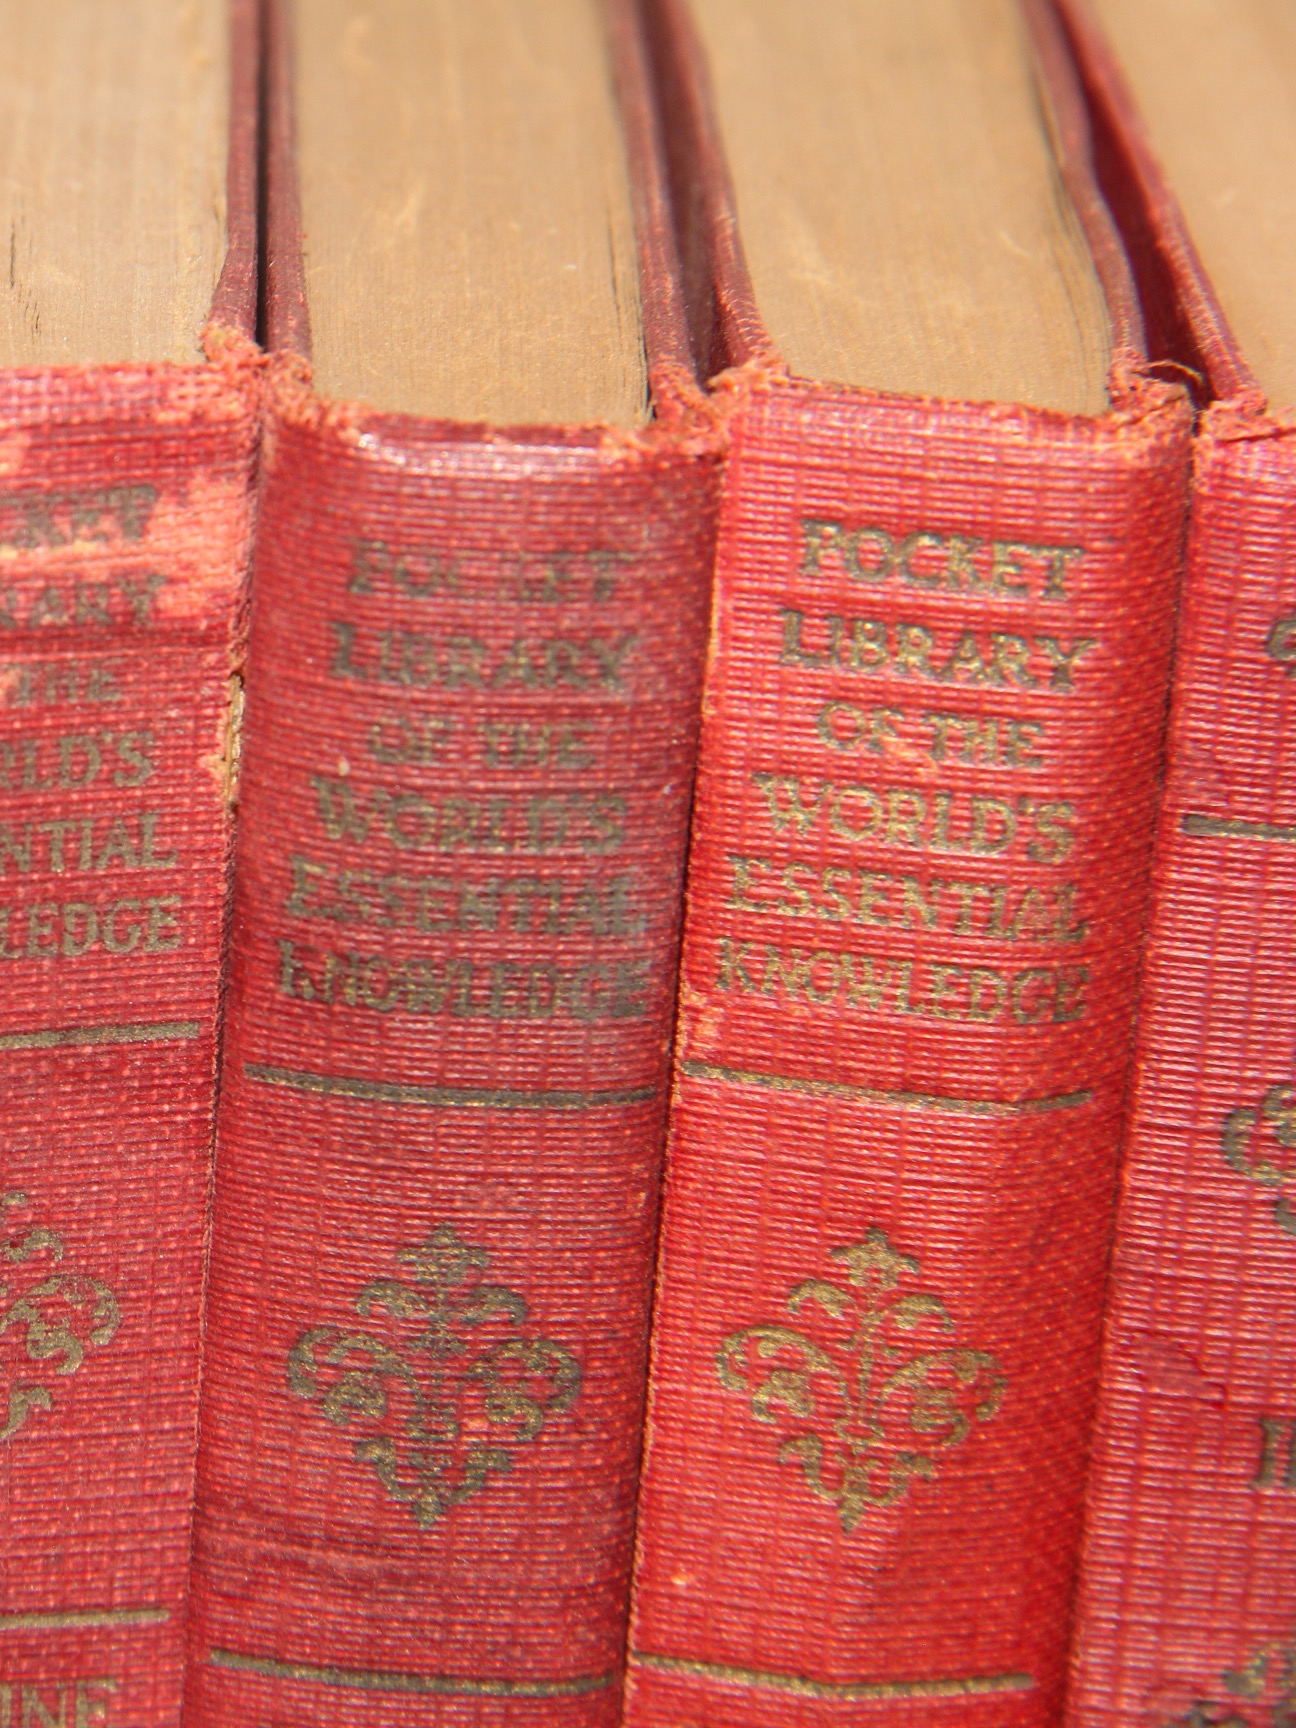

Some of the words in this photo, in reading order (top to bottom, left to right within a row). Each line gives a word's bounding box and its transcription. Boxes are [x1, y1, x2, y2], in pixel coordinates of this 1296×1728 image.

[801, 519, 1086, 601] POCKET
[328, 621, 642, 694] LIBRARY
[777, 609, 1098, 694] LIBRARY
[368, 714, 456, 767] OF
[480, 720, 598, 771] THE
[816, 701, 904, 753] OF
[922, 712, 1046, 769] THE
[311, 775, 629, 854] WORLD'S
[750, 771, 1076, 865] WORLD'S
[285, 852, 648, 936] ESSENTIAL
[726, 855, 1089, 943] ESSENTIAL
[277, 938, 652, 1021] KNOWLEDGE
[714, 937, 1093, 1024] KNOWLEDGE
